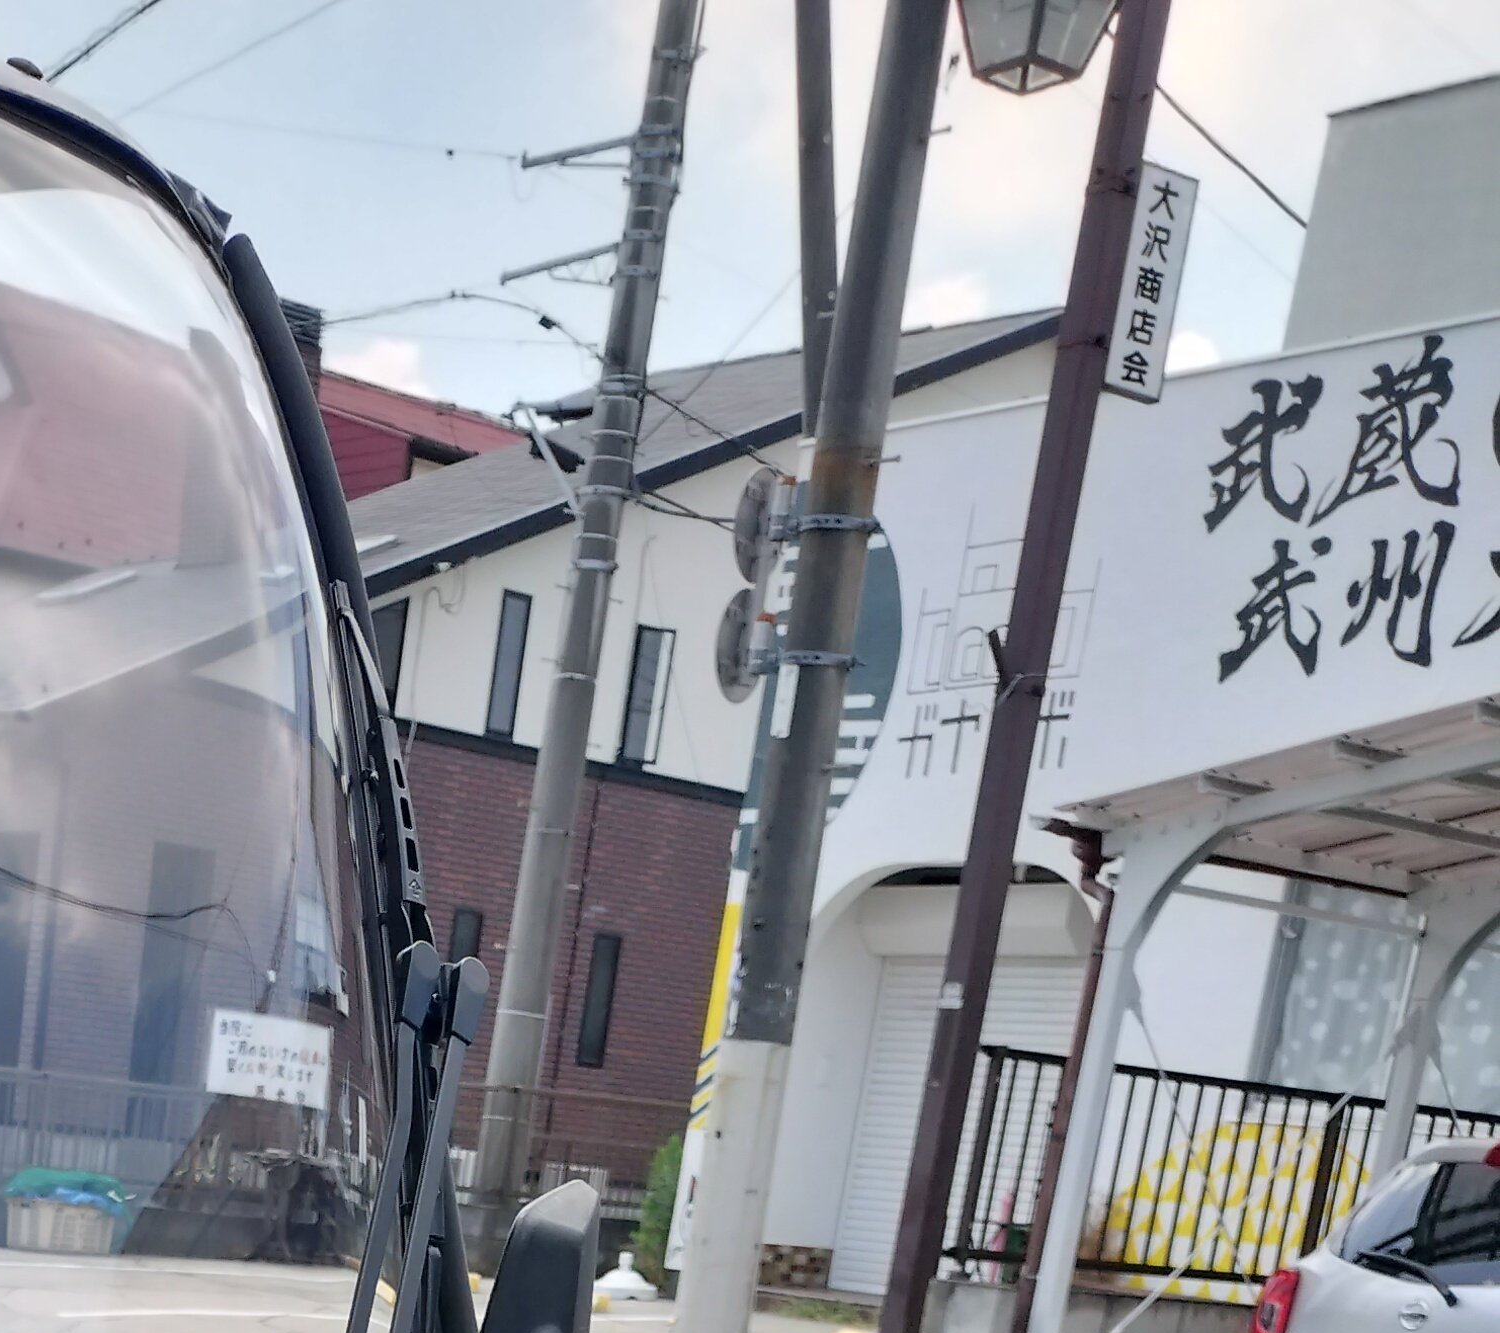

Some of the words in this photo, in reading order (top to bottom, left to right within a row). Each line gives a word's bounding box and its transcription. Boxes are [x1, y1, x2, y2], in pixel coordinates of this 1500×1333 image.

[1121, 180, 1180, 387] 大沢商店会
[1203, 334, 1500, 534] 武蔵
[1219, 520, 1500, 684] 武州
